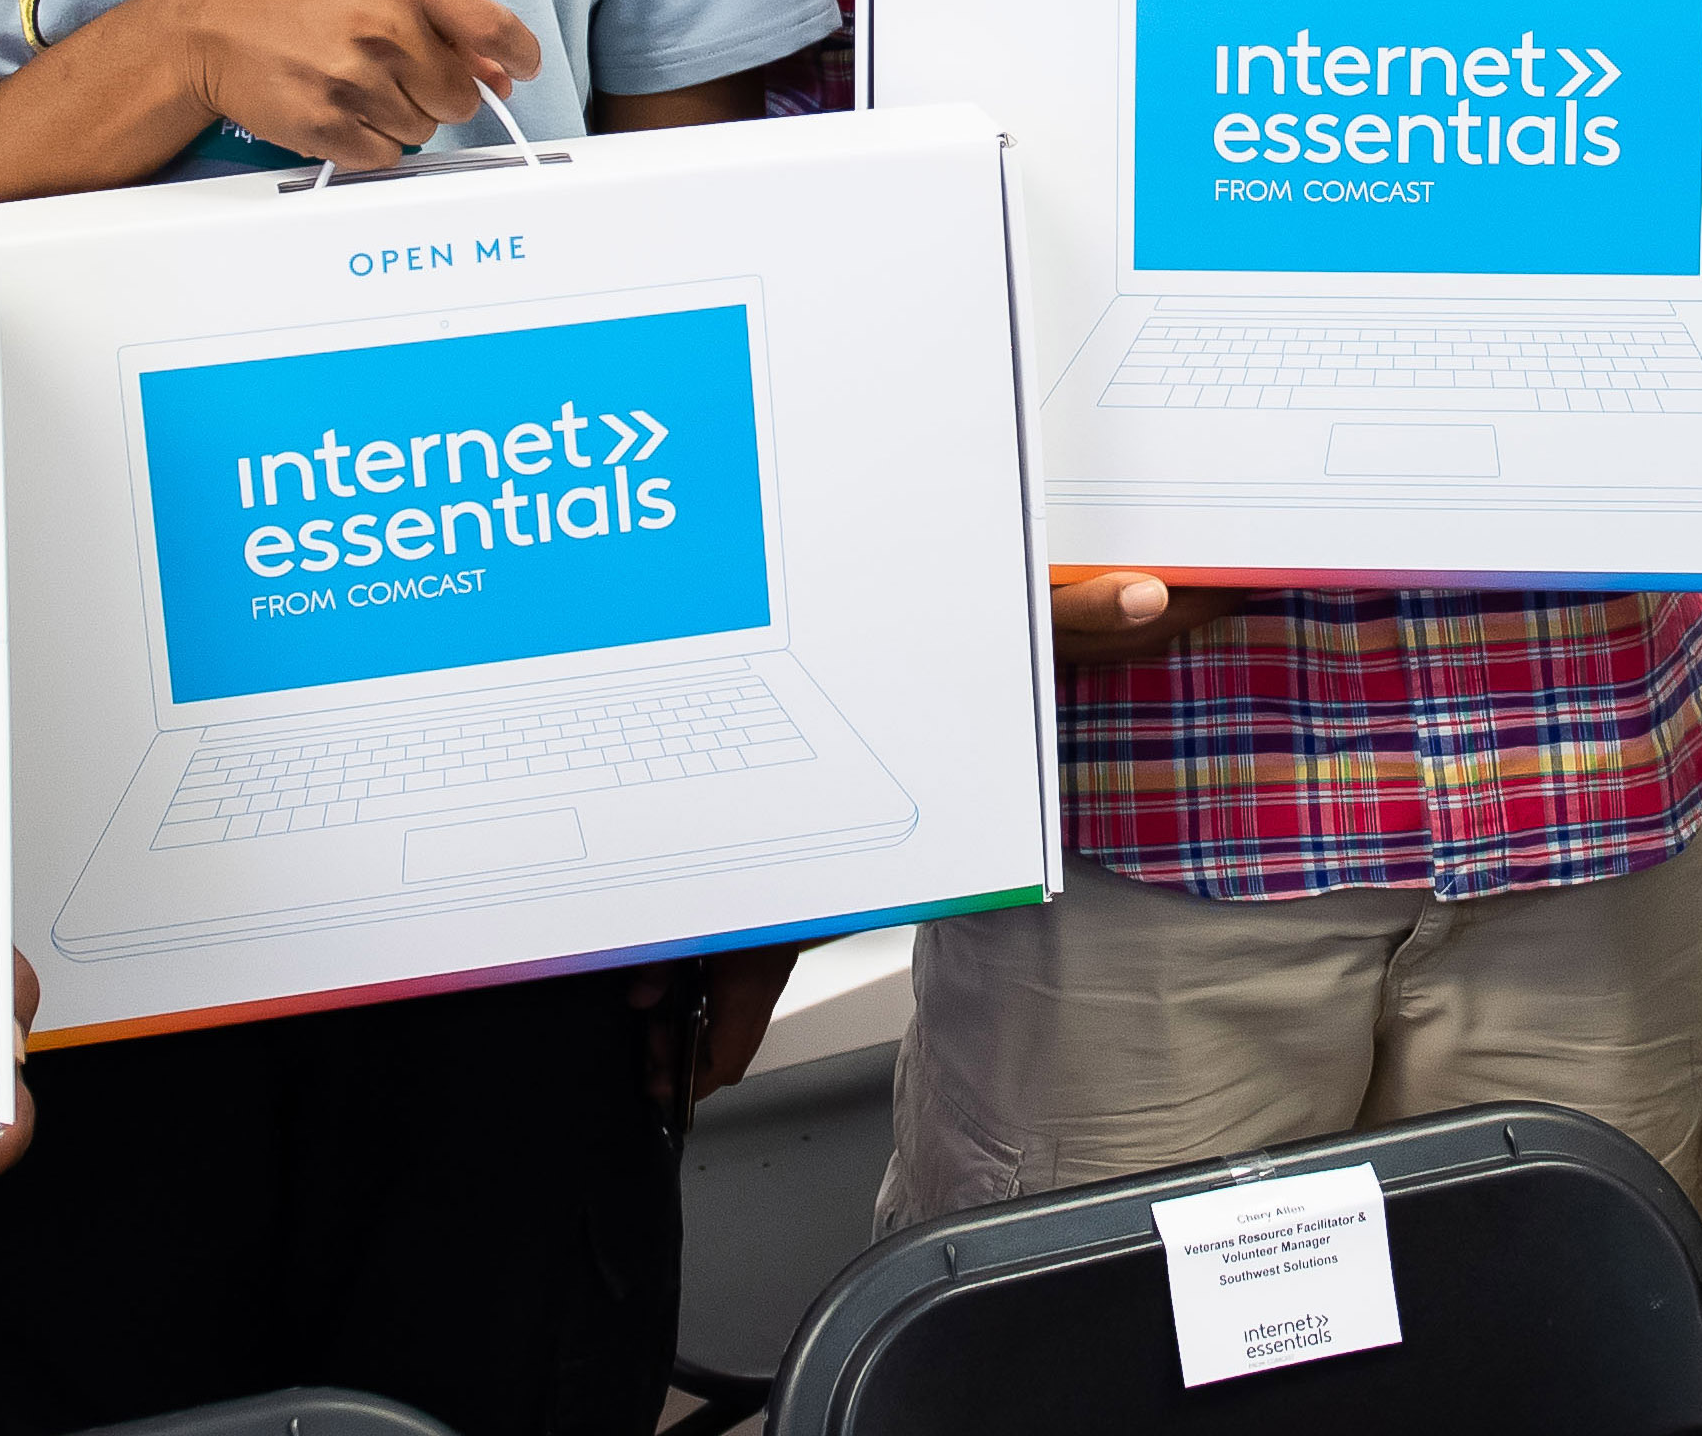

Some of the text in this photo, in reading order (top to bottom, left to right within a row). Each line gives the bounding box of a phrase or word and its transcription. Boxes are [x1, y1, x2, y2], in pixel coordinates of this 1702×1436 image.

[1215, 28, 1546, 98] internet
[1212, 98, 1621, 167] essentials
[1214, 179, 1436, 204] FROM COMCAST
[348, 235, 526, 277] OPEN ME
[237, 400, 592, 509] internet
[244, 465, 677, 578] essentials
[251, 569, 486, 620] FROM COMCAST
[1184, 1211, 1367, 1256] Veterans Resource Facilitator &
[1222, 1235, 1331, 1264] Volunteer Manager
[1219, 1254, 1339, 1286] Southwest Solutions
[1244, 1314, 1313, 1344] internet
[1246, 1328, 1333, 1359] essentials
